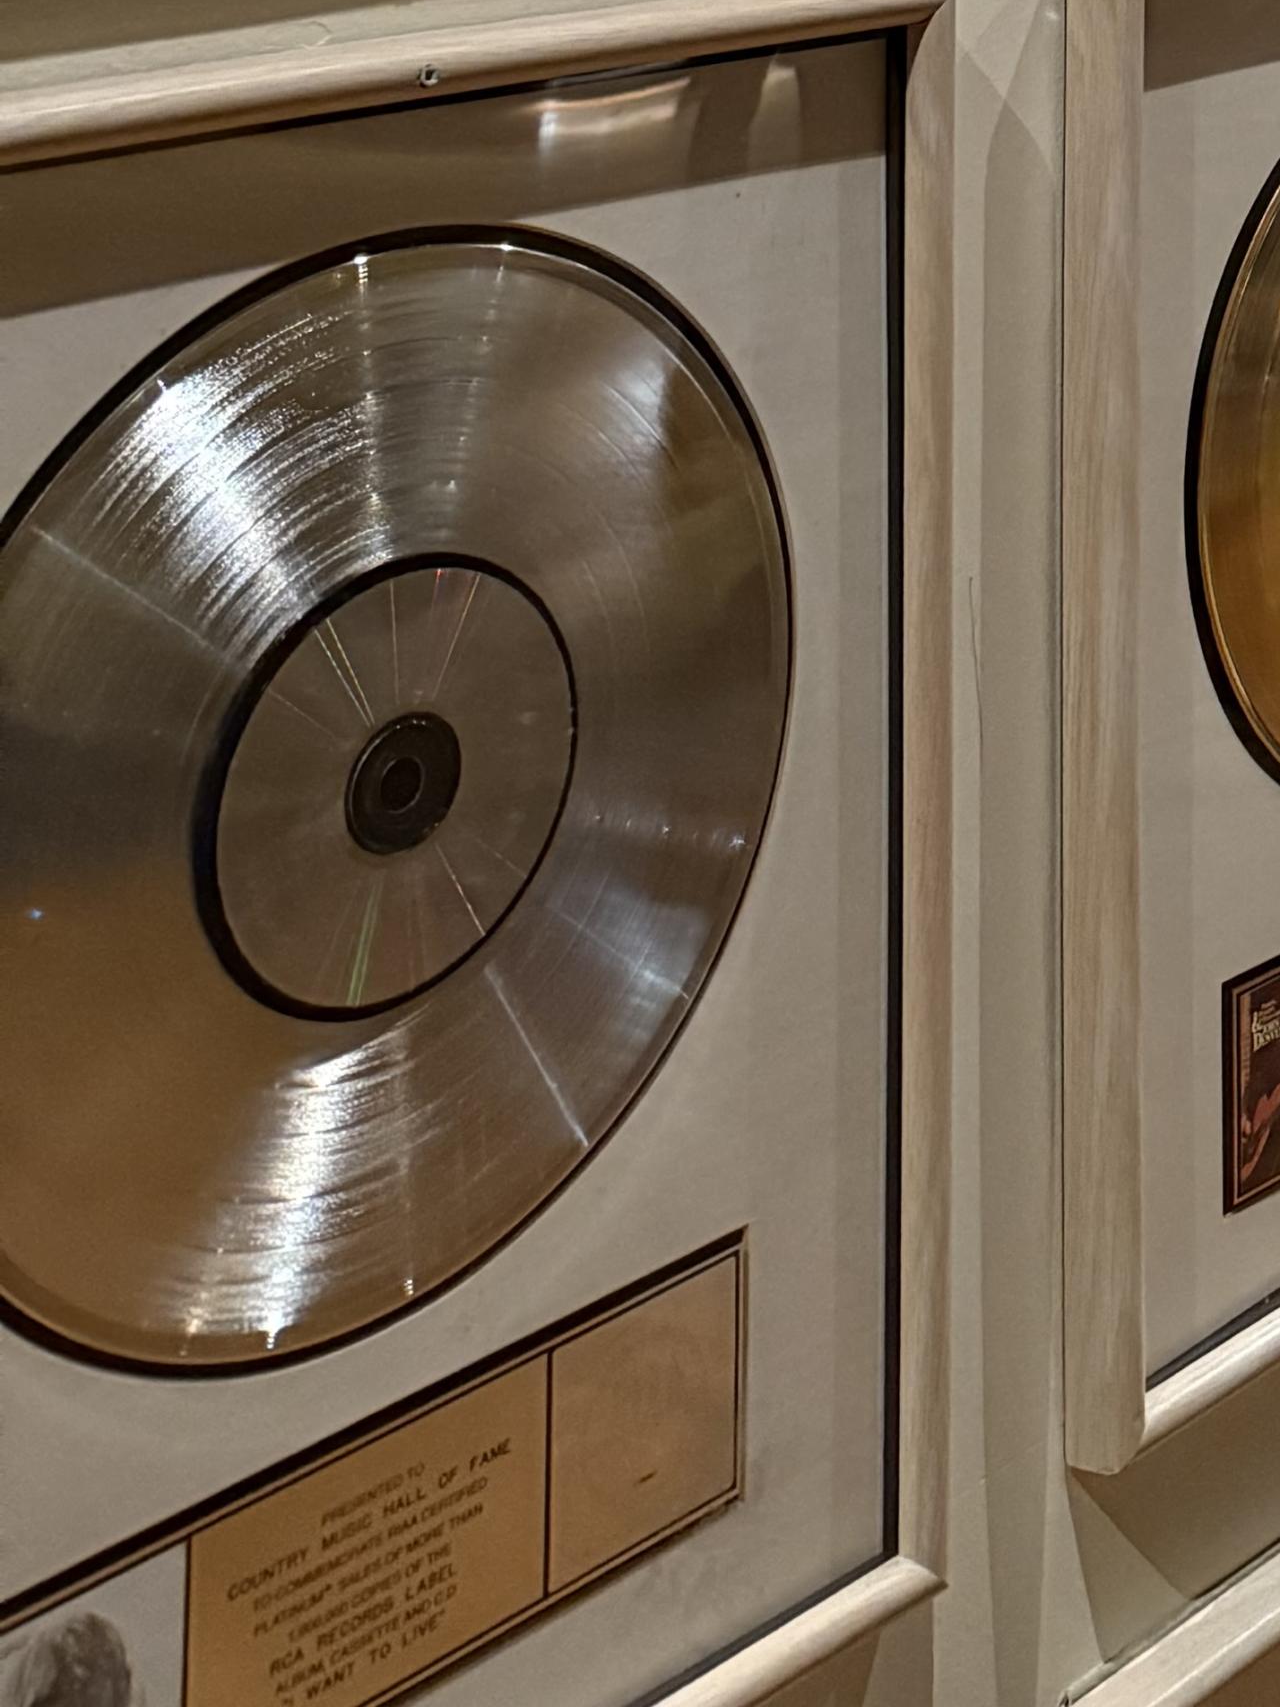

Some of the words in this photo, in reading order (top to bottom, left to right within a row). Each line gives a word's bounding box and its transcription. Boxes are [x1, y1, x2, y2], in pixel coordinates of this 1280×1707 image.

[227, 1548, 307, 1600] COUNTRY
[321, 1513, 371, 1550] MUSIC
[382, 1487, 426, 1517] HALL
[437, 1465, 457, 1489] OF
[469, 1438, 510, 1470] FAME
[268, 1648, 303, 1676] RCA
[316, 1596, 393, 1649] RECORDS
[404, 1563, 456, 1600] LABEL
[306, 1660, 354, 1697] WANT
[369, 1642, 391, 1664] TO
